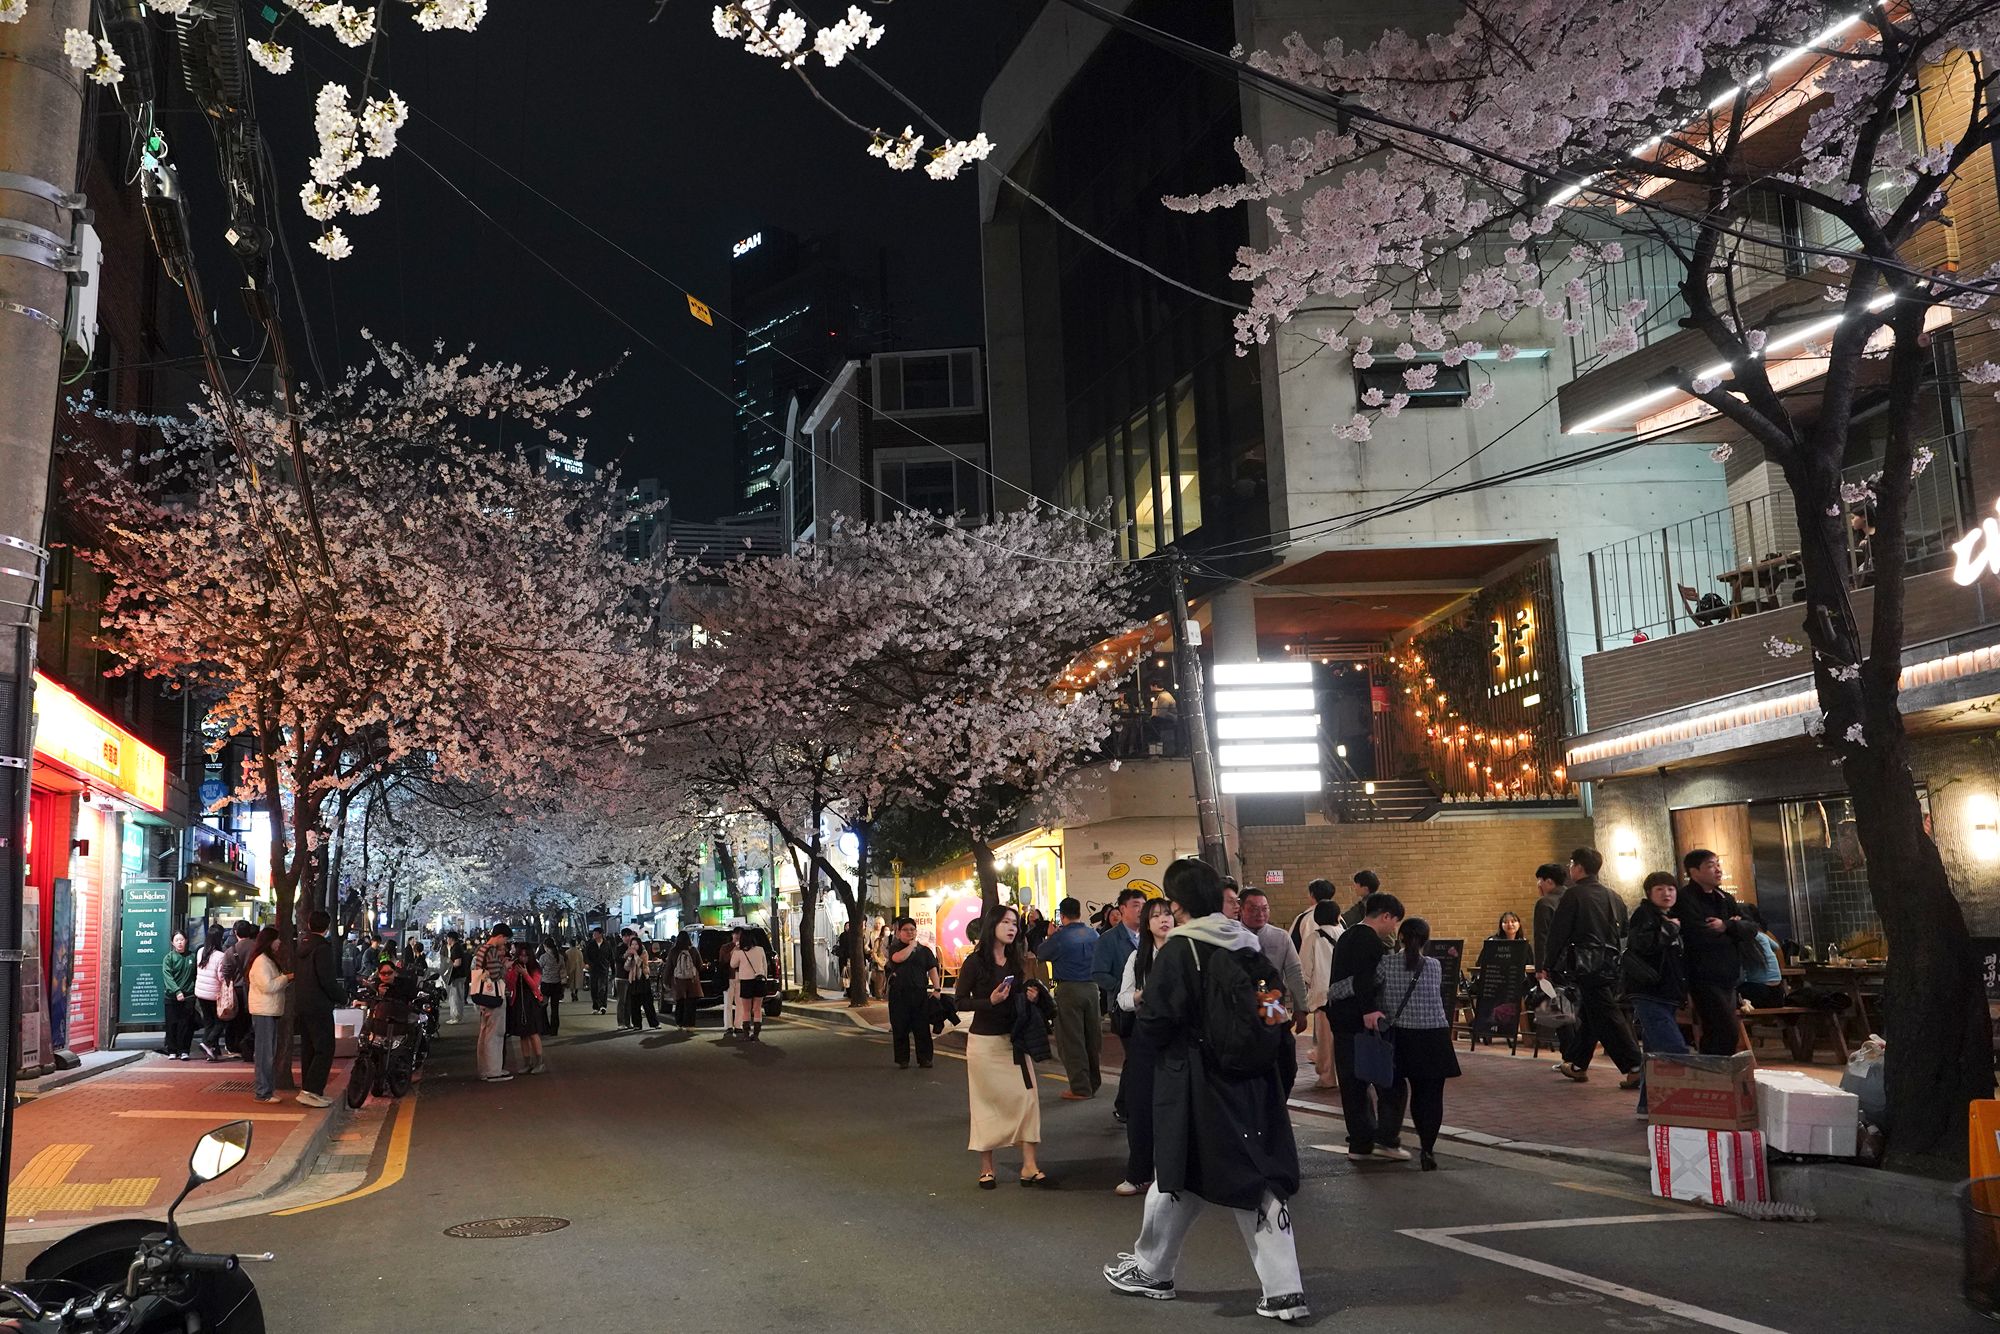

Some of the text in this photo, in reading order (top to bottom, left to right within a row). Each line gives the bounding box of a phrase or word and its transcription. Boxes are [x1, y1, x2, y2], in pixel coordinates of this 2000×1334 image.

[556, 462, 583, 475] PUGIO
[1487, 669, 1539, 699] IZAKAYA
[202, 784, 219, 792] BREW
[129, 891, 143, 900] Sun
